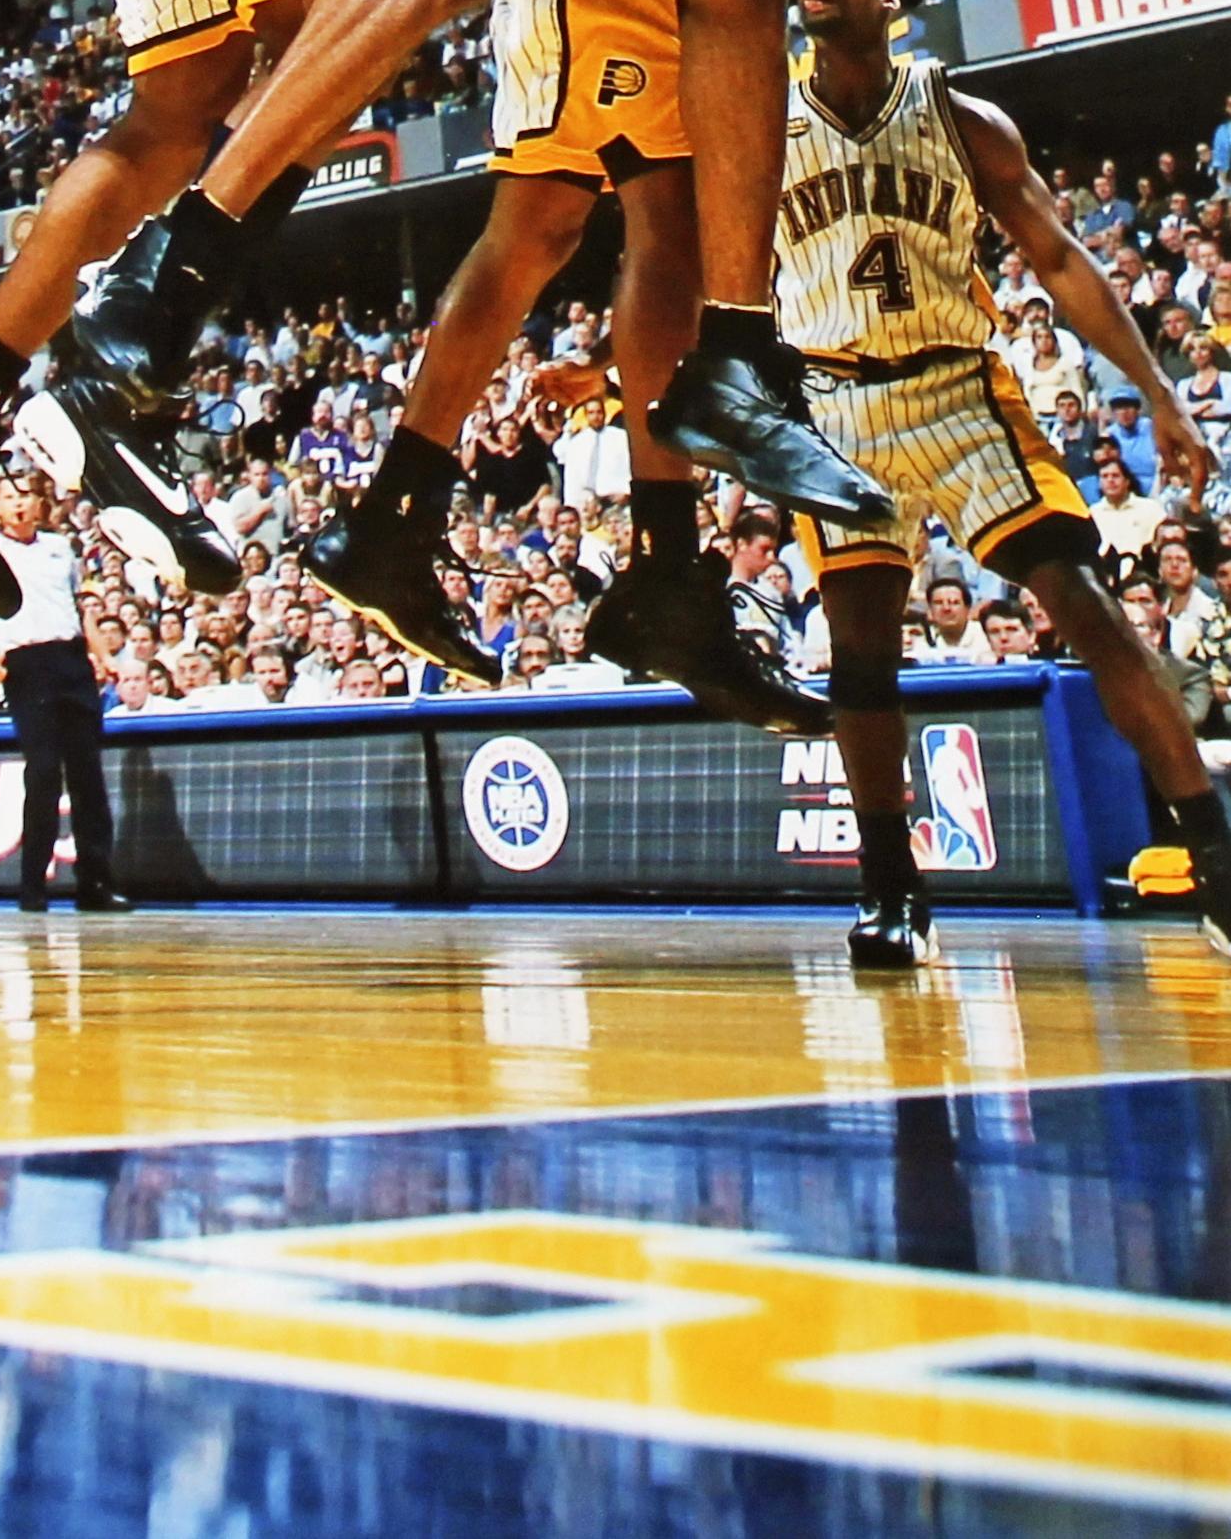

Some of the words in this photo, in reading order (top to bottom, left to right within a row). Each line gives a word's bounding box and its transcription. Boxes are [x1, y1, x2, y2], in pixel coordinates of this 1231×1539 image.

[307, 154, 383, 189] ACING
[779, 163, 957, 246] INDIANA
[848, 232, 916, 313] 4
[777, 809, 863, 853] NB
